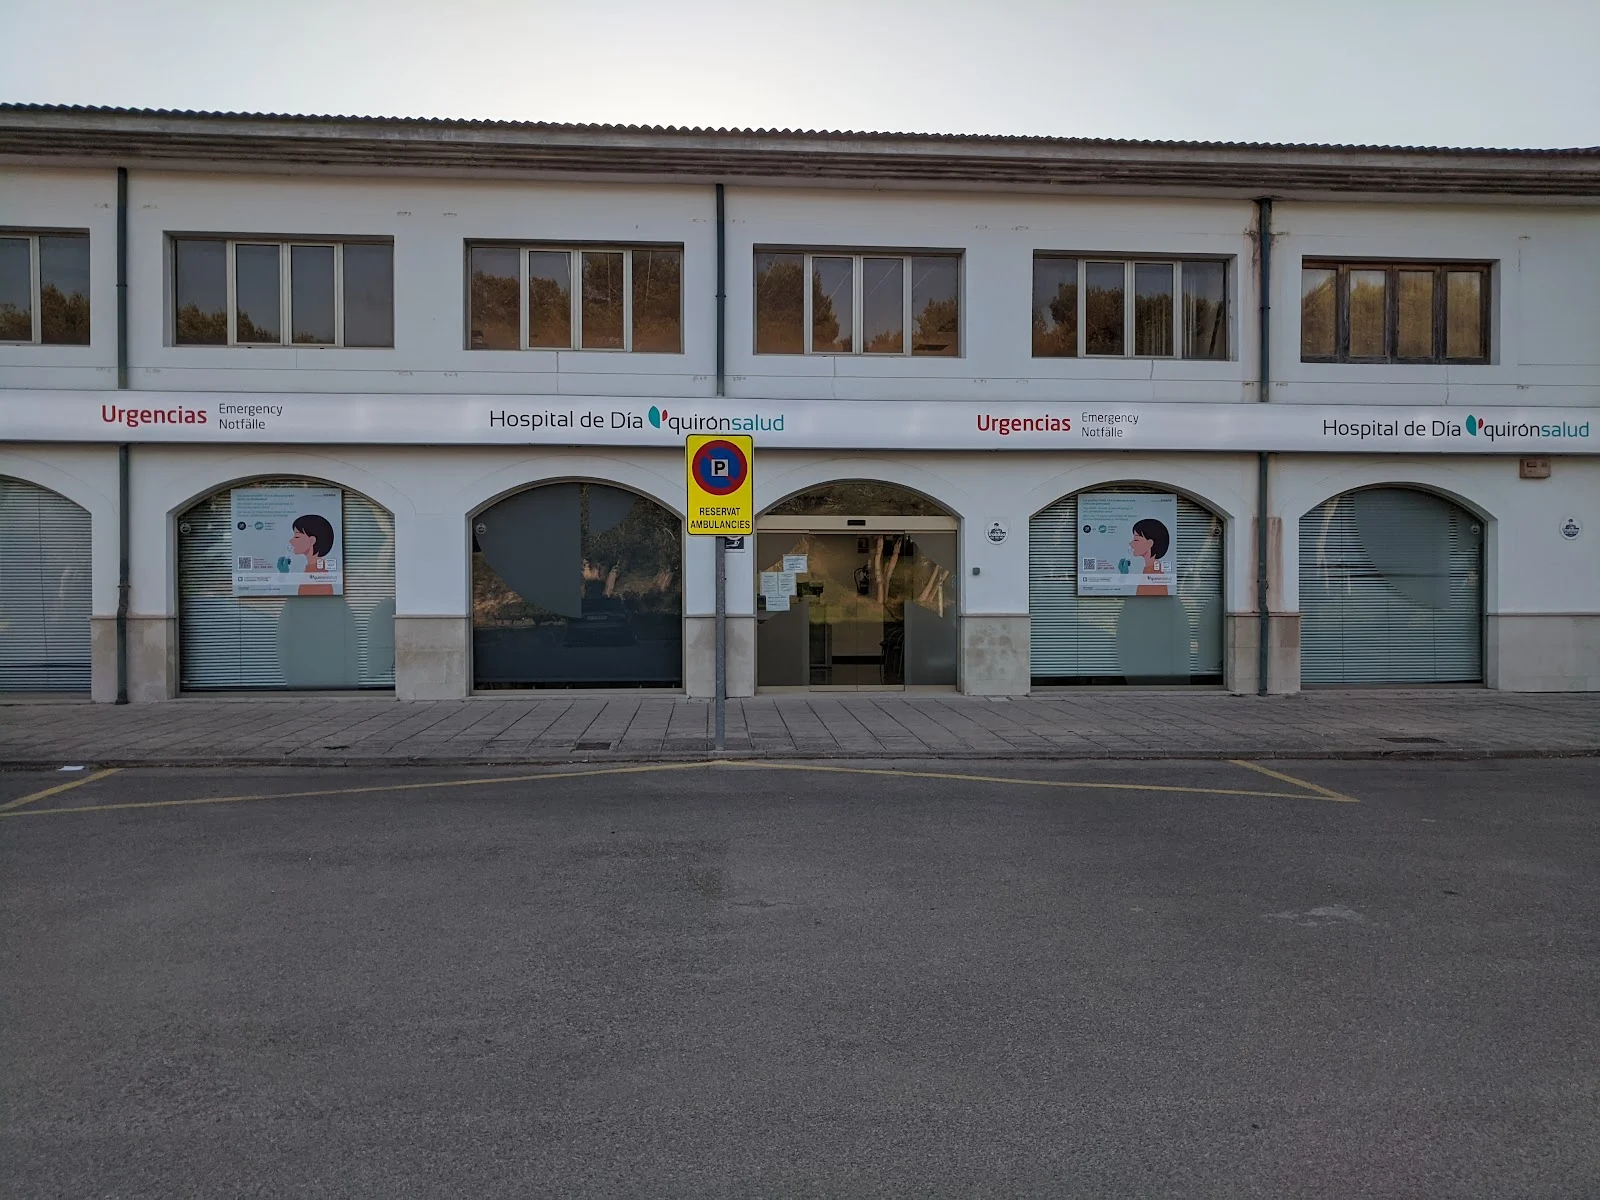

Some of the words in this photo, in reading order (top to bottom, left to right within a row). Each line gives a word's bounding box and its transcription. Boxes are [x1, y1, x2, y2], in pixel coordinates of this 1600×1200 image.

[102, 405, 207, 428] Urgencias
[219, 403, 283, 417] Emergency
[219, 418, 266, 430] Notfälle
[489, 410, 573, 432] Hospital
[580, 411, 604, 429] de
[611, 411, 643, 429] Día
[668, 414, 784, 435] quirónsalud
[977, 414, 1071, 436] Urgencias
[1081, 411, 1139, 425] Emergency
[1081, 427, 1124, 438] Notfälle
[1323, 419, 1398, 440] Hospital
[1404, 420, 1426, 437] de
[1432, 420, 1461, 437] Día
[1484, 421, 1589, 442] quirónsalud
[714, 460, 726, 475] P
[699, 507, 741, 516] RESERVAT
[690, 520, 751, 529] AMBULANCIES
